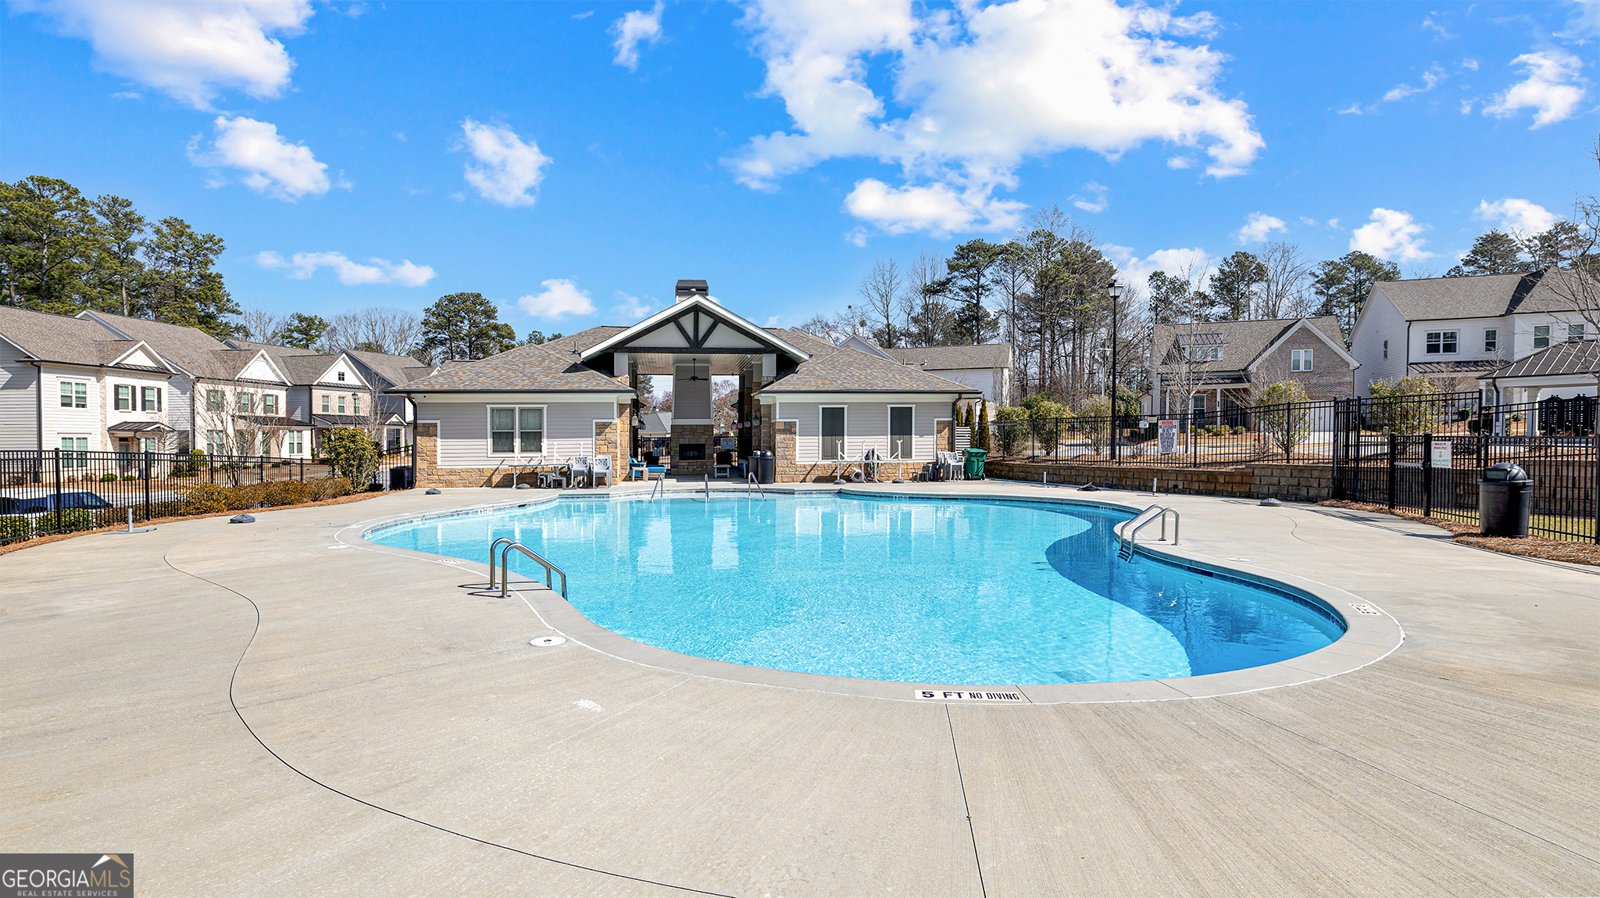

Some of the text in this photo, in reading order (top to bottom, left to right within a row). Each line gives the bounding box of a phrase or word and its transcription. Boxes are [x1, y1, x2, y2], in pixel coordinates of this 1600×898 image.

[942, 691, 964, 699] FT
[968, 692, 983, 700] NO
[986, 692, 1020, 700] DIVING
